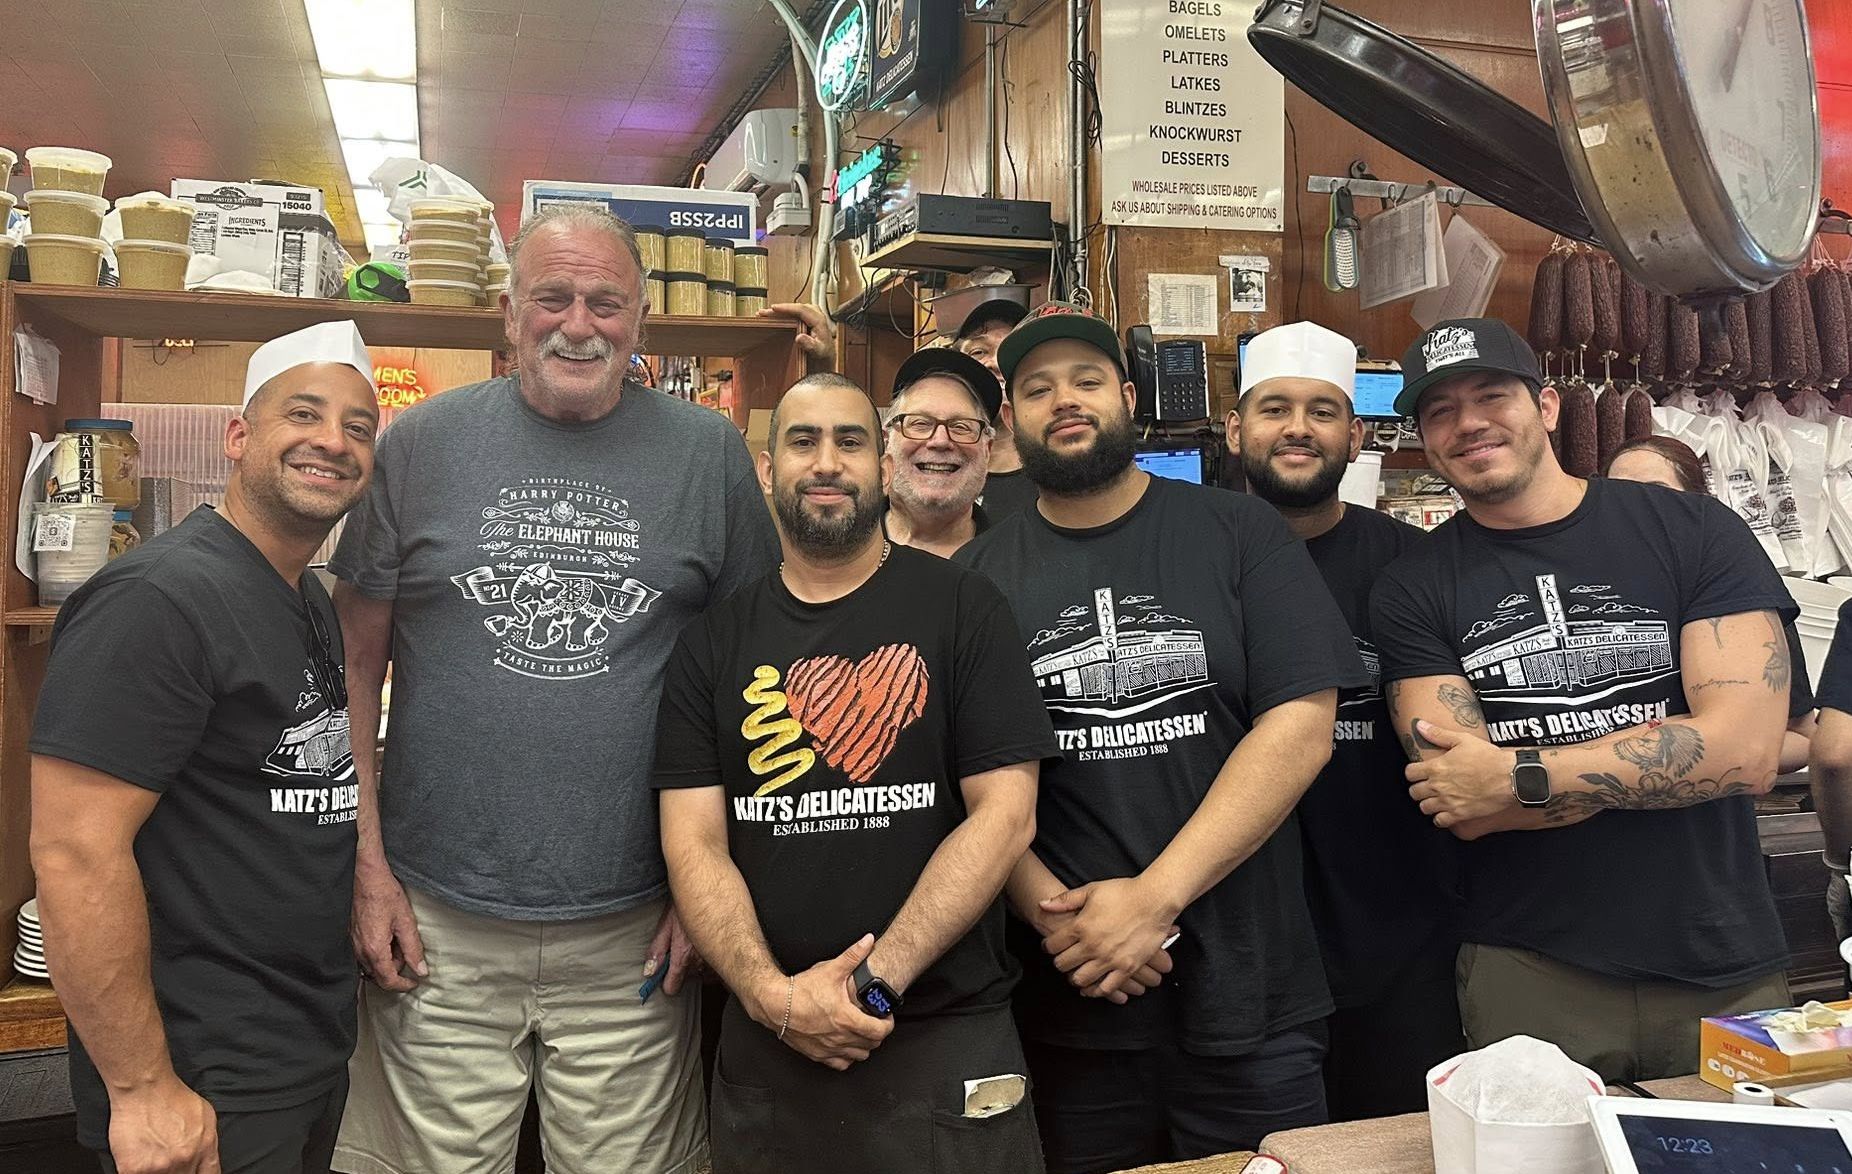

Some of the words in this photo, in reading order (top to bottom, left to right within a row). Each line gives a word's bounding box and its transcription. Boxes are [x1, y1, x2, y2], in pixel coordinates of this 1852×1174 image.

[1169, 0, 1222, 16] BAGELS
[1165, 25, 1226, 42] OMELETS
[1163, 50, 1228, 67] PLATTERS
[1171, 76, 1221, 91] LATKES
[1165, 101, 1227, 117] BLINTZES
[1150, 125, 1242, 143] KNOCKWURST
[1162, 151, 1229, 167] DESSERTS
[1132, 180, 1178, 194] WHOLESALE
[1179, 183, 1205, 195] PRICES
[1207, 184, 1232, 197] LISTED
[1233, 186, 1257, 198] ABOVE
[282, 201, 312, 211] 15040
[1111, 200, 1127, 213] ASK
[1128, 201, 1139, 213] US
[1140, 201, 1166, 214] ABOUT
[1167, 204, 1201, 216] SHIPPING
[1202, 205, 1208, 216] &
[1209, 205, 1245, 218] CATERING
[1246, 207, 1277, 219] OPTIONS
[229, 216, 266, 227] INGREDIENTS
[669, 211, 743, 229] IPP2SSB
[376, 387, 417, 406] OOM
[81, 435, 92, 493] KATZ'S
[529, 478, 589, 488] BIRTHPLACE
[510, 489, 557, 500] HARRY
[567, 491, 620, 511] POTTER
[480, 520, 514, 539] The
[518, 524, 592, 544] ELEPHANT
[594, 531, 639, 549] HOUSE
[533, 551, 587, 563] EDINBURGH
[1541, 577, 1564, 635] KATZ'S
[1100, 591, 1114, 648] KATZ'S
[1567, 635, 1594, 647] KATZ'S
[1595, 631, 1667, 645] DELICATESSEN
[1117, 648, 1138, 658] ATZ'S
[1139, 642, 1200, 655] DELICATESSEN
[503, 651, 536, 670] TASTE
[542, 664, 562, 672] THE
[568, 658, 602, 672] MAGIC
[1091, 714, 1206, 748] DELICATESSEN
[1487, 717, 1543, 743] KATZ'S
[1079, 746, 1148, 762] ESTABLISHED
[1150, 744, 1169, 756] 1888
[270, 787, 329, 813] KATZ'S
[734, 795, 794, 822] KATZ'S
[796, 782, 936, 819] DELICATESSEN
[863, 816, 890, 830] 1888
[1656, 1136, 1713, 1155] 12:23
